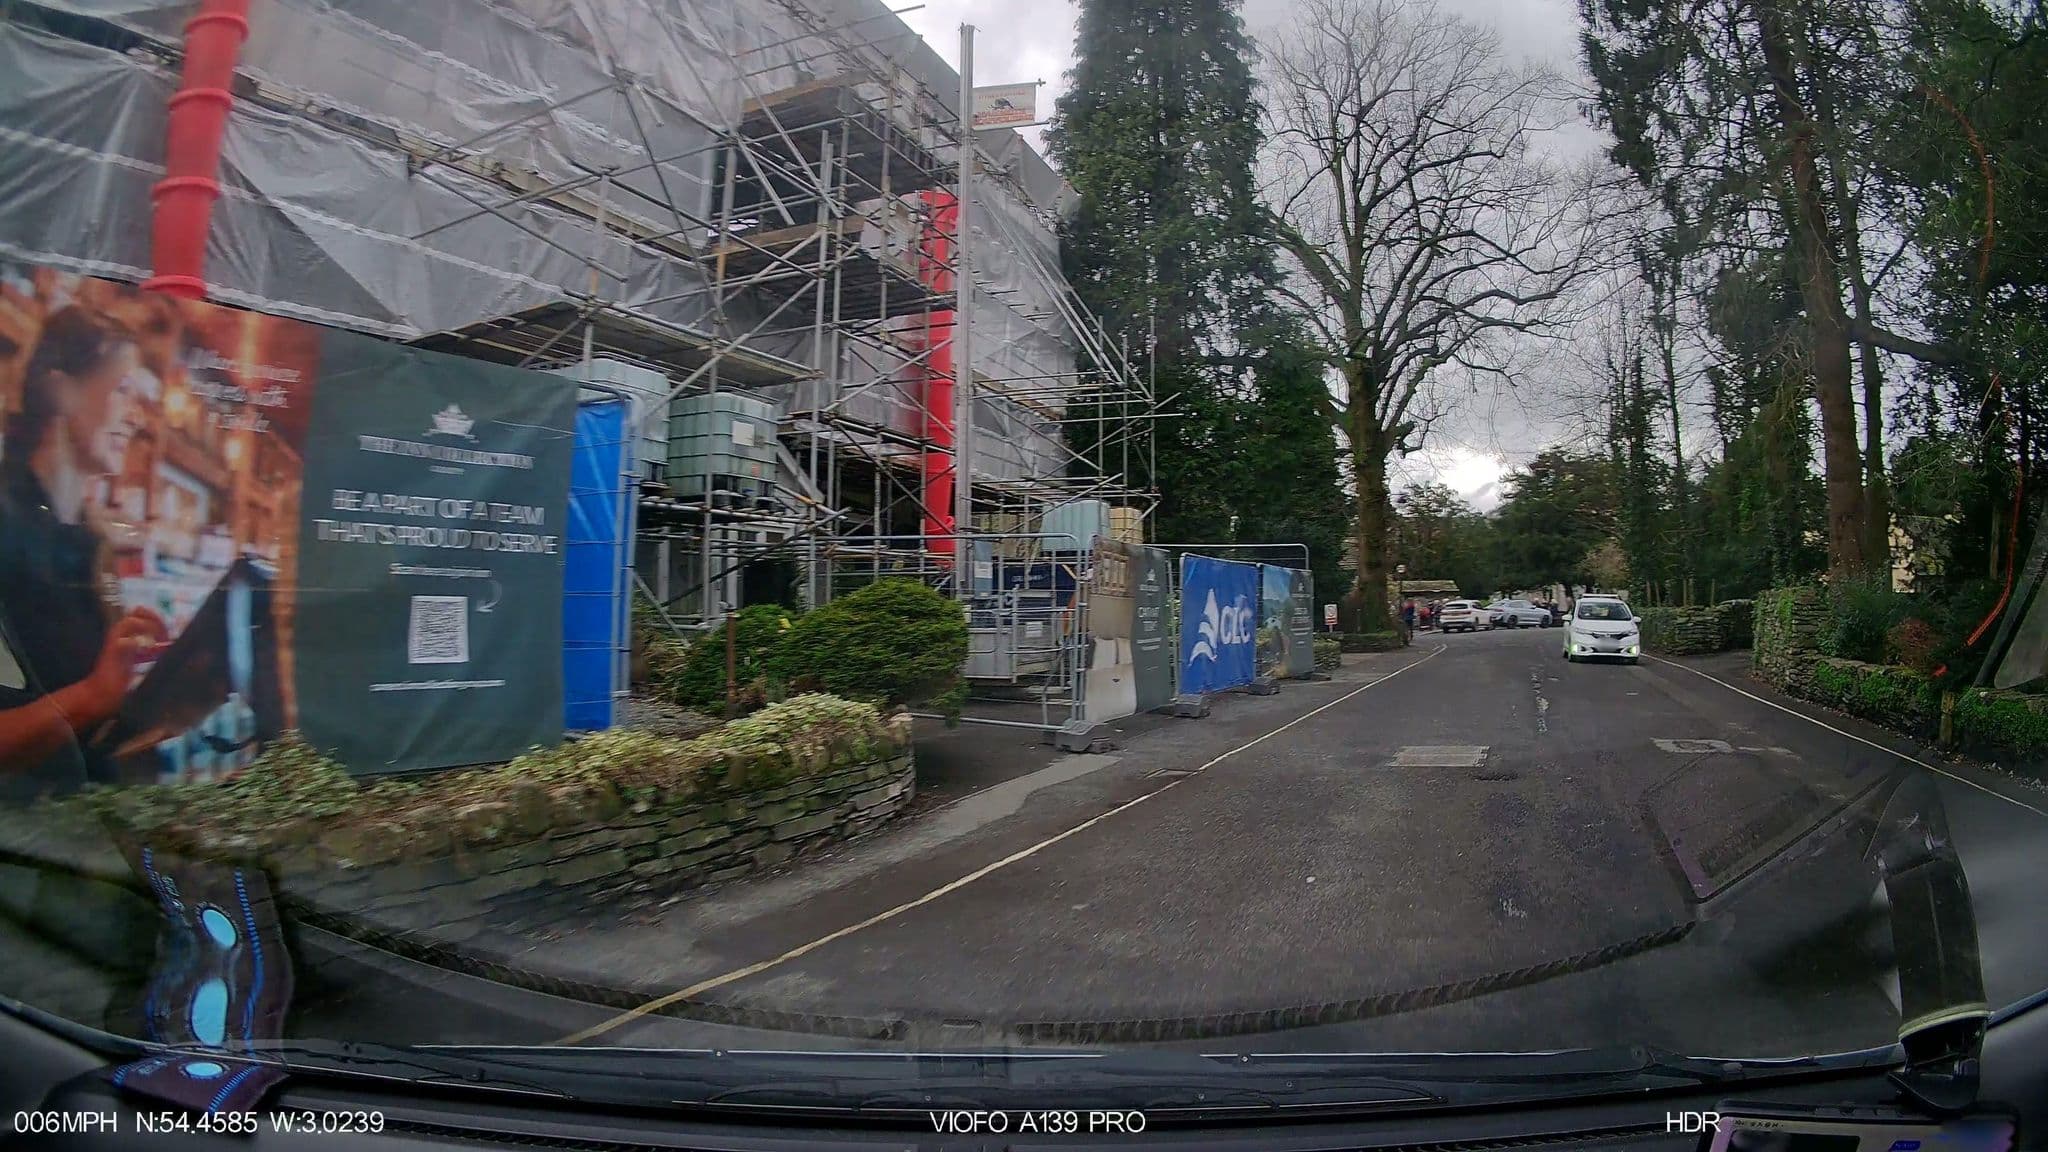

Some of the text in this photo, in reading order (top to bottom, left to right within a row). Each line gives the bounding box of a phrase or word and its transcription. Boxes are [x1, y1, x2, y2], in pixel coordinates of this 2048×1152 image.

[332, 489, 544, 525] BE A PART OF A TEAM
[396, 525, 471, 550] PROUD
[470, 530, 501, 551] TO
[498, 533, 558, 554] SERVE
